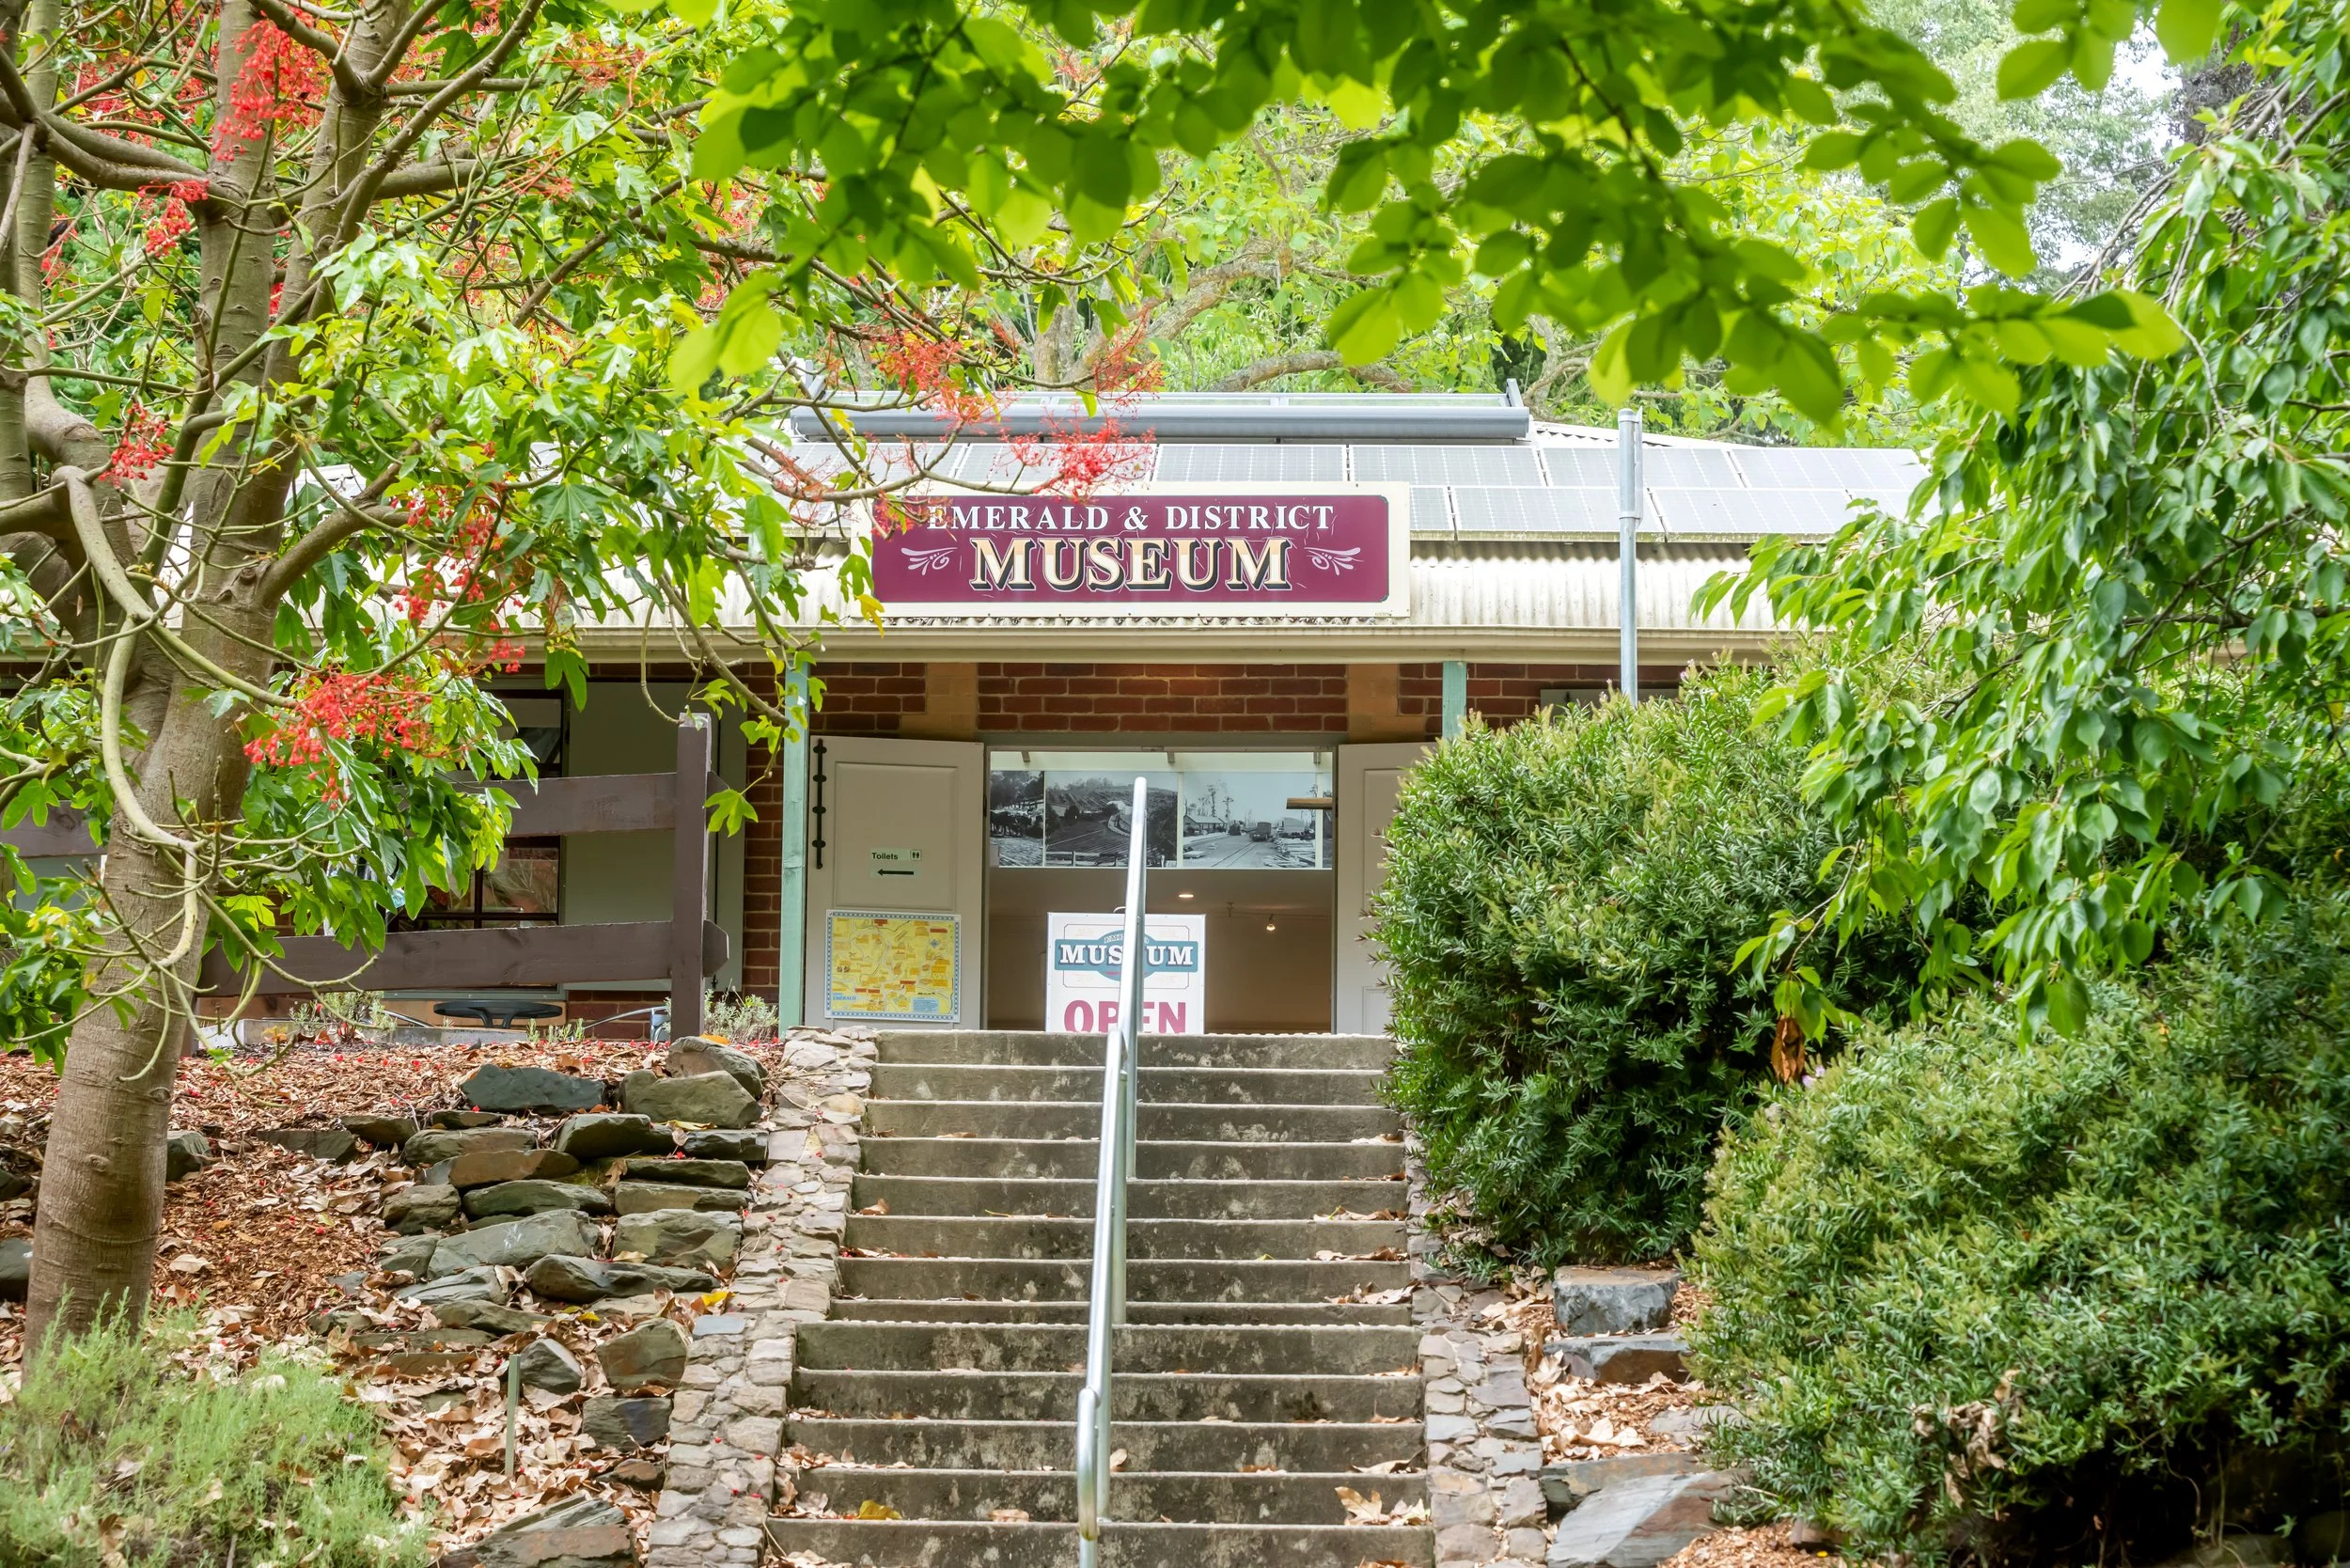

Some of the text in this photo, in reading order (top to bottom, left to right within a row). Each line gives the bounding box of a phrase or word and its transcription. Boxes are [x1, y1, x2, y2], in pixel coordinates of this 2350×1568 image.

[927, 505, 1334, 530] EMERALD & DISTRICT
[969, 537, 1292, 591] MUSEUM
[871, 852, 899, 860] Toilets
[1059, 944, 1193, 965] MUSUM
